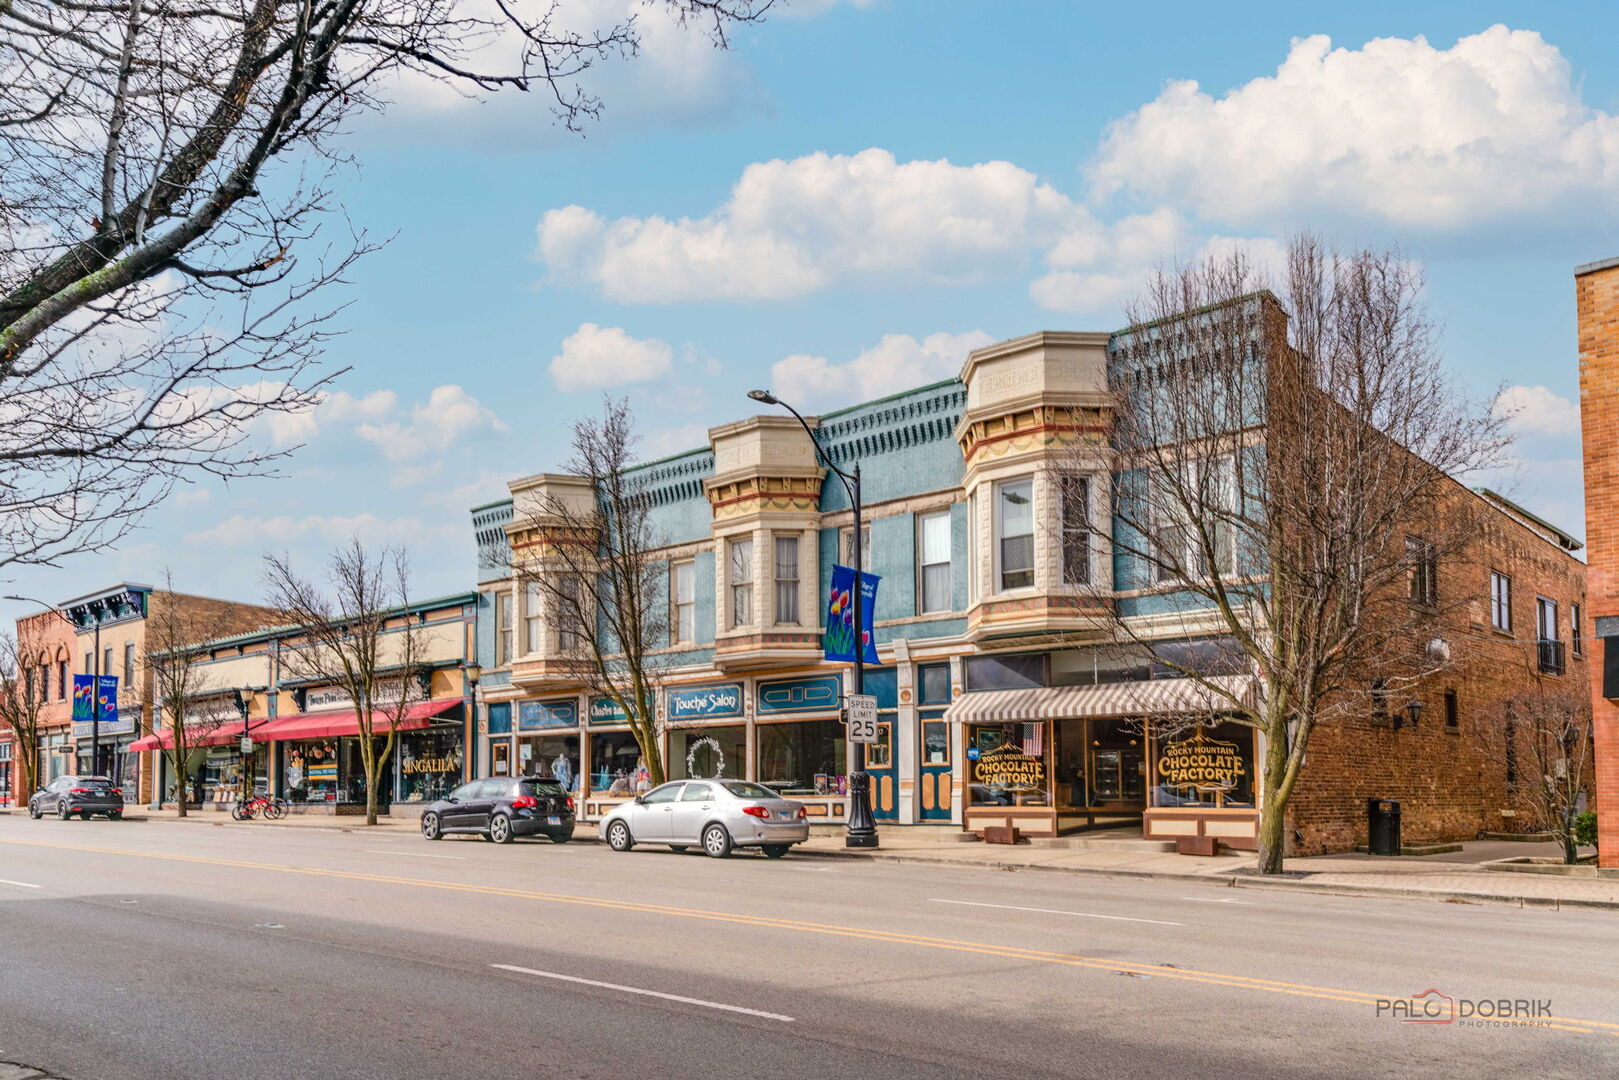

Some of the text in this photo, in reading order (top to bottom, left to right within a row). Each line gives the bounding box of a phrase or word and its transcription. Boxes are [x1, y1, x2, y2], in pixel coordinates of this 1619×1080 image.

[707, 693, 736, 712] Salon
[851, 700, 875, 709] SPEED
[853, 710, 872, 719] LIMIT
[852, 720, 875, 737] 25
[983, 755, 1003, 763] ROCKY
[1167, 746, 1234, 757] ROCKY MOUNTAIN
[402, 757, 455, 774] SINGALILA
[975, 760, 1045, 781] CHOCOLATE
[1158, 754, 1246, 776] CHOCOLATE
[985, 772, 1035, 785] FACTORY
[1170, 767, 1232, 782] FACTORY
